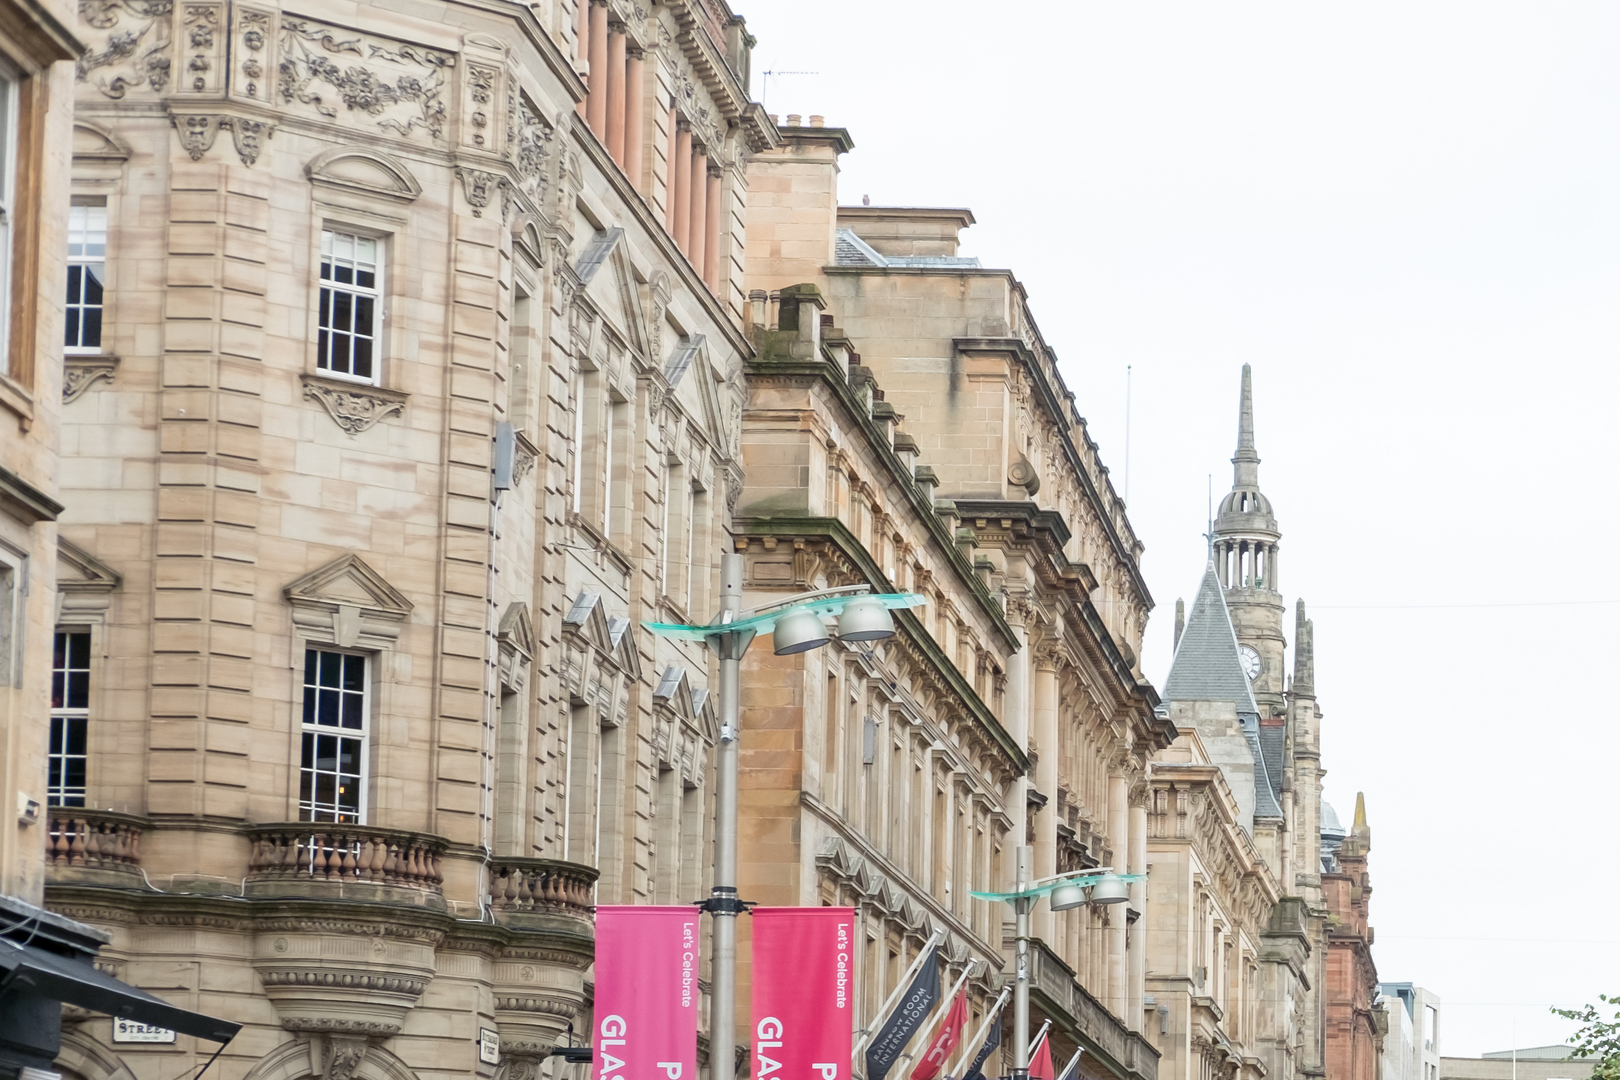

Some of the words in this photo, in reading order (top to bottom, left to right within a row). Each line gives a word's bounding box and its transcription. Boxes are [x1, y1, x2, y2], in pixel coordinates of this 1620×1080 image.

[683, 922, 694, 949] Let's
[837, 923, 849, 950] Let's
[681, 951, 694, 1008] Celebrate
[836, 952, 849, 1009] Celebrate
[874, 1018, 903, 1060] RAINBOW
[902, 987, 927, 1016] ROOM
[879, 994, 933, 1065] INTERNATIONAL
